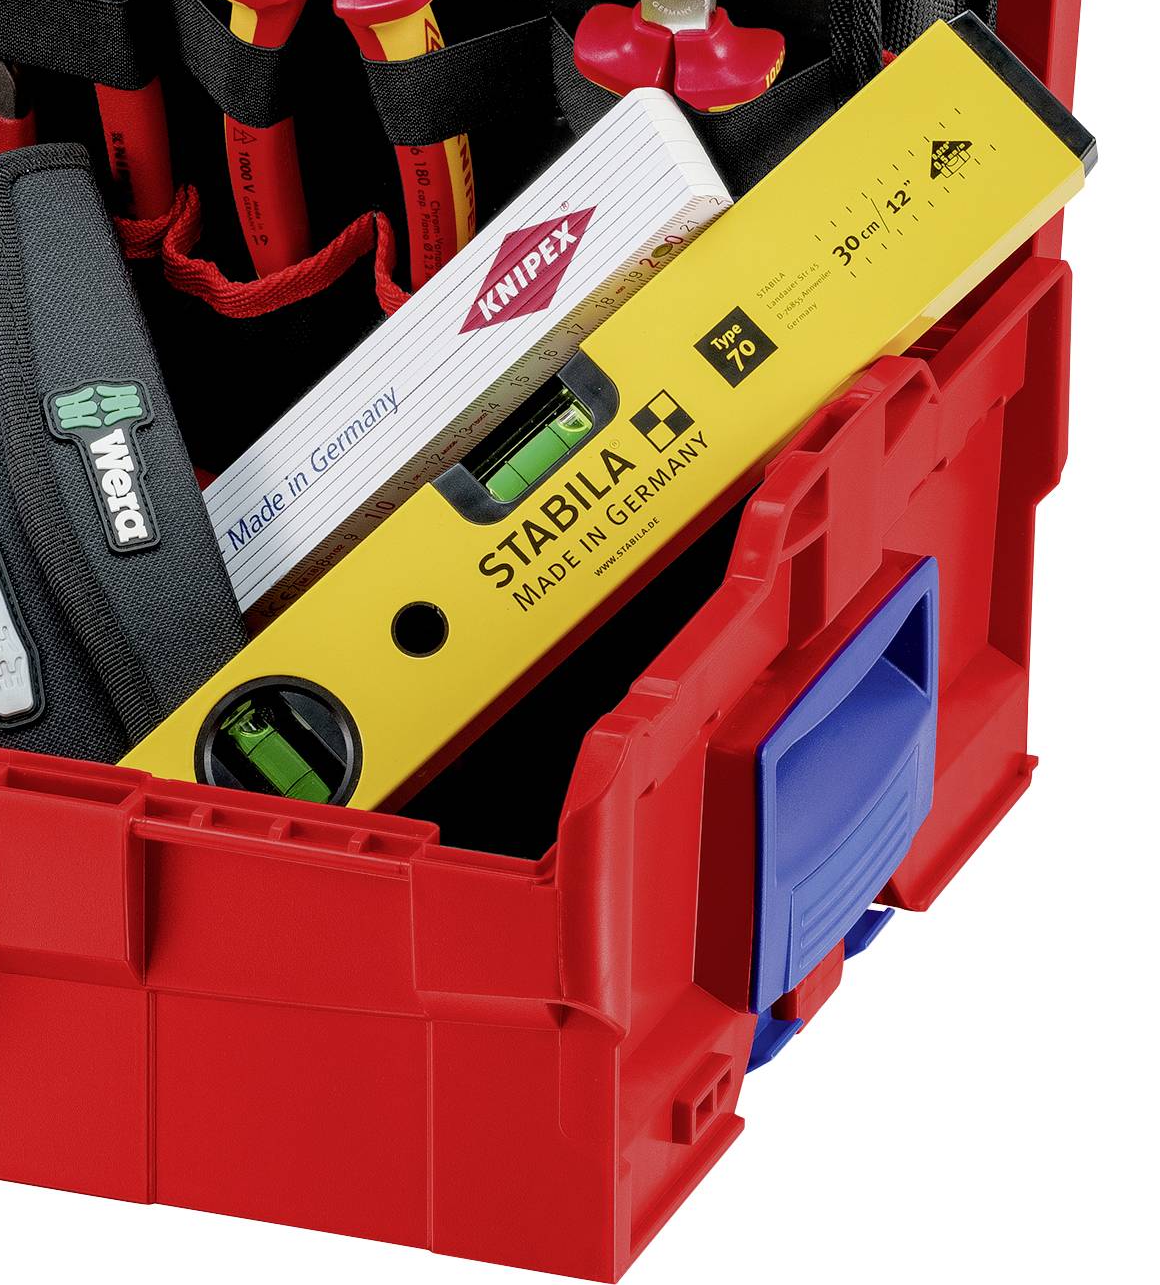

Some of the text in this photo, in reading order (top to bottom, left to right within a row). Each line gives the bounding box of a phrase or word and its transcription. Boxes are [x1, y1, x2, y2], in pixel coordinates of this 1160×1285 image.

[652, 1, 692, 16] GERMANY
[238, 151, 253, 181] 1000
[415, 162, 431, 187] 180
[457, 134, 477, 244] NIPE
[832, 235, 860, 266] 30
[860, 221, 880, 240] cm
[477, 220, 577, 322] KNIPEX
[756, 272, 786, 299] STABILA
[766, 280, 799, 309] Landauer
[786, 302, 818, 331] Germany
[710, 324, 742, 351] Type
[726, 339, 756, 372] 70
[90, 428, 148, 543] Wera
[227, 387, 399, 551] Made in Germany
[478, 448, 636, 589] STABILA
[512, 431, 709, 612] MADE IN GERMANY
